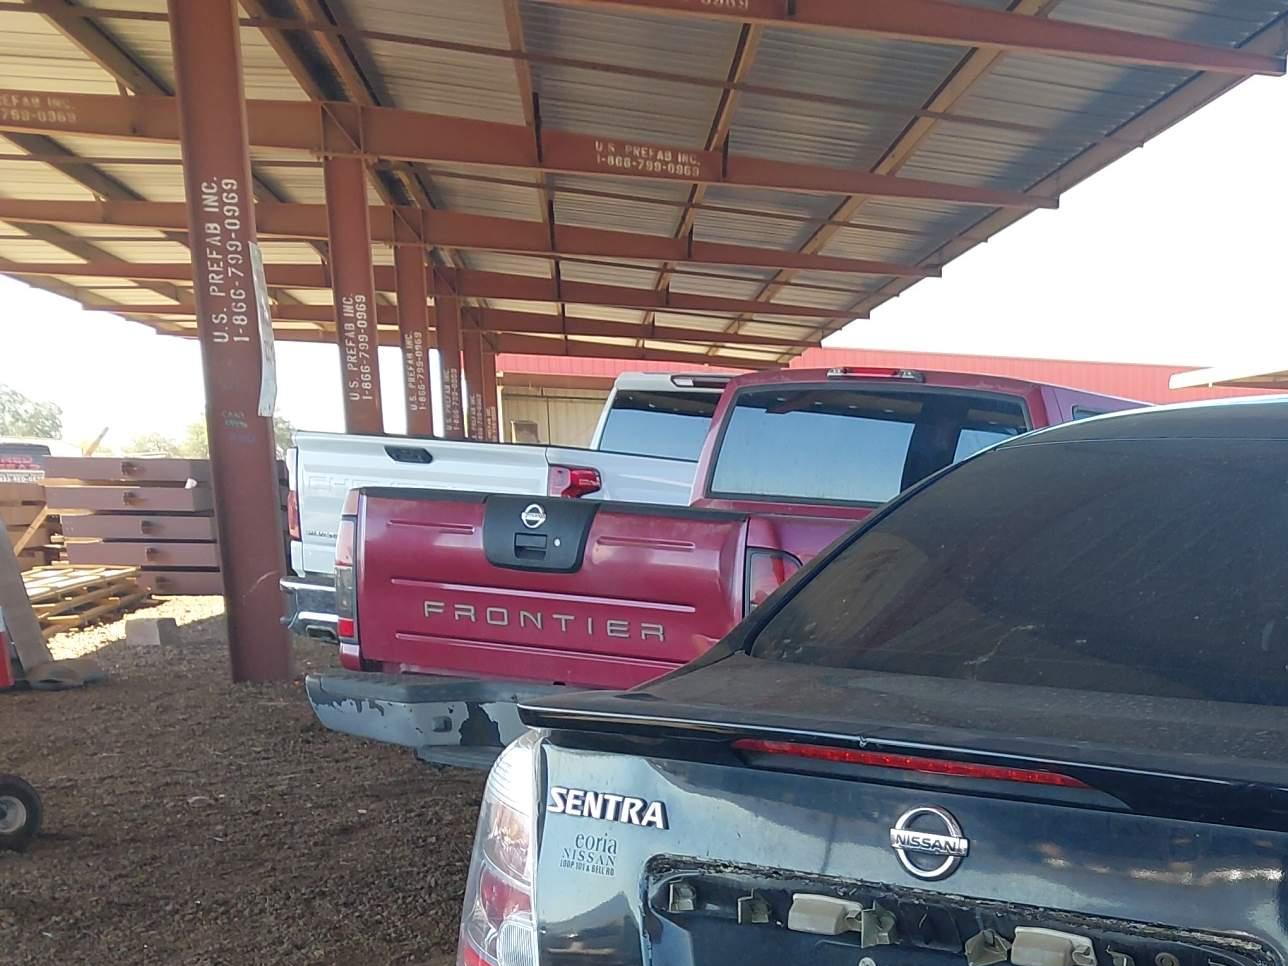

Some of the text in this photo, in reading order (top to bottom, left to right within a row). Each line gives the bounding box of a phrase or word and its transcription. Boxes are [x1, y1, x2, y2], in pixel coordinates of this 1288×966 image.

[625, 145, 672, 161] PREFAB
[201, 176, 229, 343] U.S. PREFAB INC.
[221, 178, 250, 342] 1-866-799-0969
[344, 322, 360, 371] PREFAB
[355, 294, 373, 400] 1-866-799-0969
[424, 600, 665, 642] FRONTIER
[546, 786, 670, 830] SENTRA
[561, 848, 617, 867] NISSAN
[895, 834, 956, 852] NISSAN
